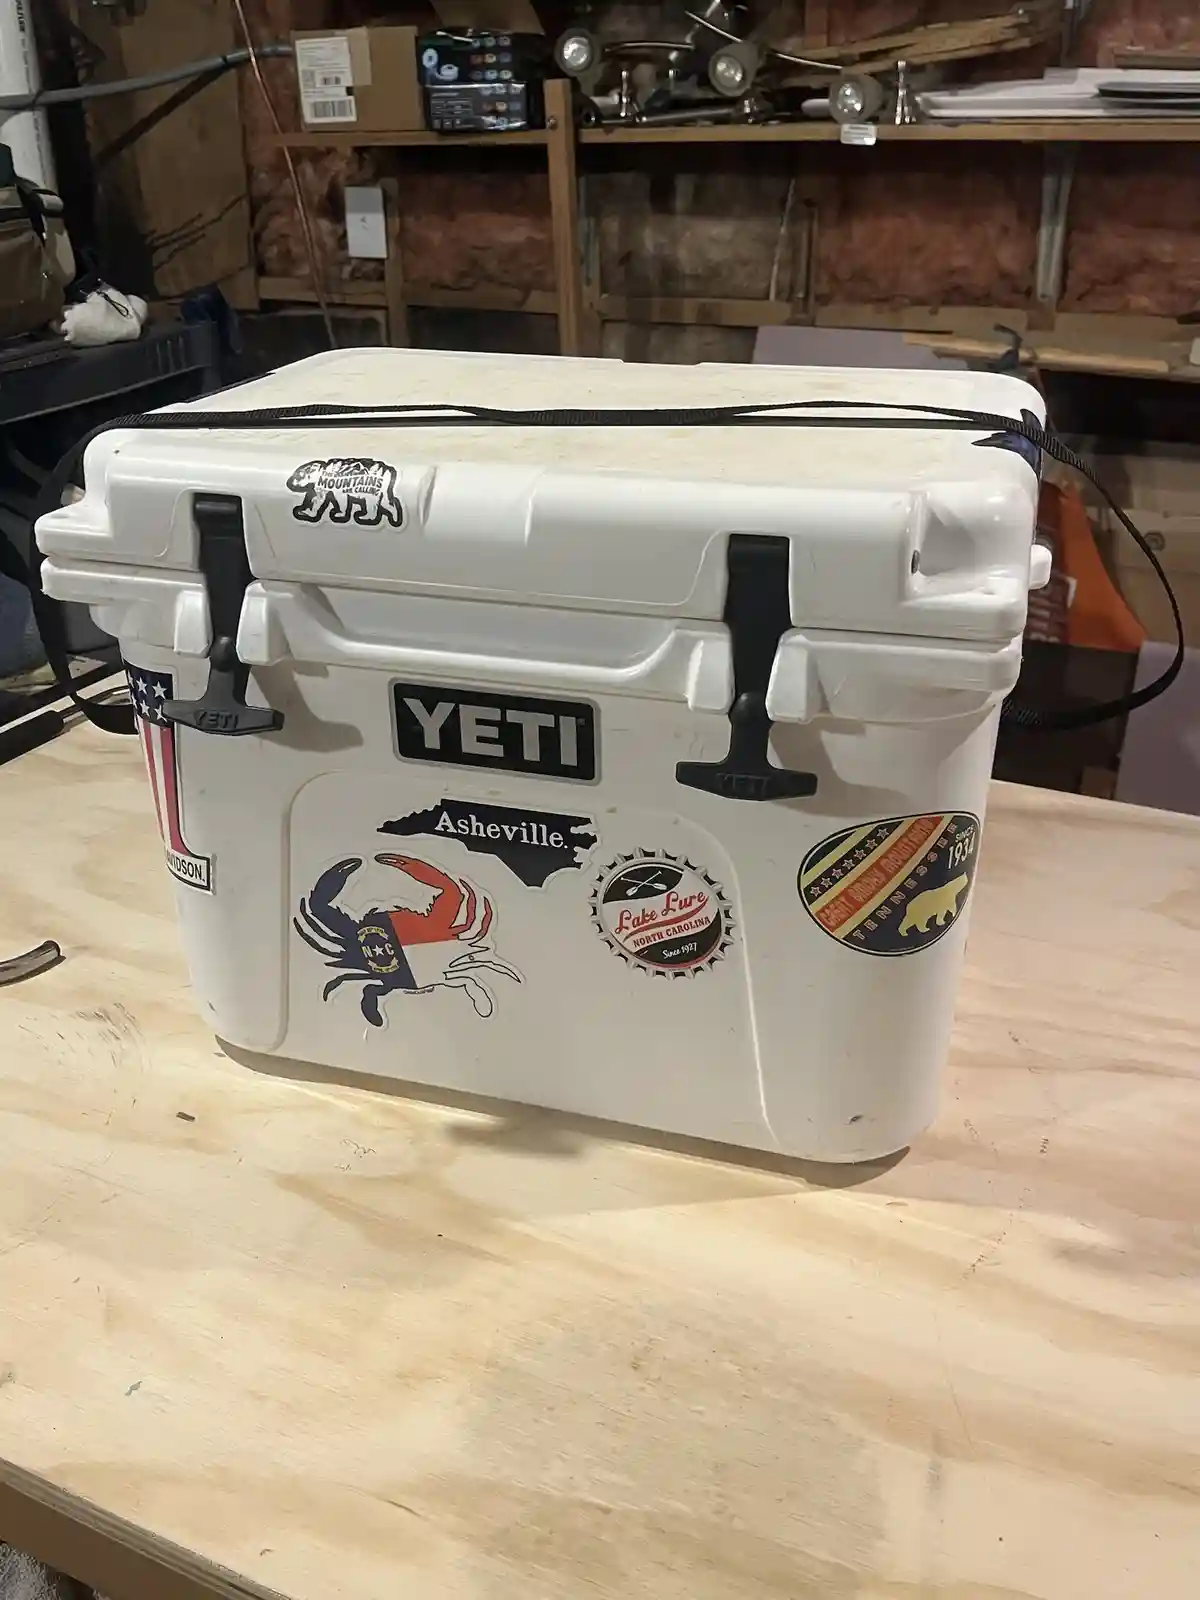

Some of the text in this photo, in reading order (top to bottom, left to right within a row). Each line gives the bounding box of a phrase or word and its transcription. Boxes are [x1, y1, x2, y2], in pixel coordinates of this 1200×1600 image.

[317, 475, 384, 492] MOUNTAINS
[354, 486, 381, 497] CALLING
[193, 708, 239, 730] YETI
[402, 697, 580, 767] YETI
[434, 810, 568, 849] Asheville.
[614, 891, 706, 935] Lake Lure
[632, 916, 711, 948] NORTH CAROLINA
[361, 942, 395, 958] N C
[662, 941, 697, 960] Since 1927
